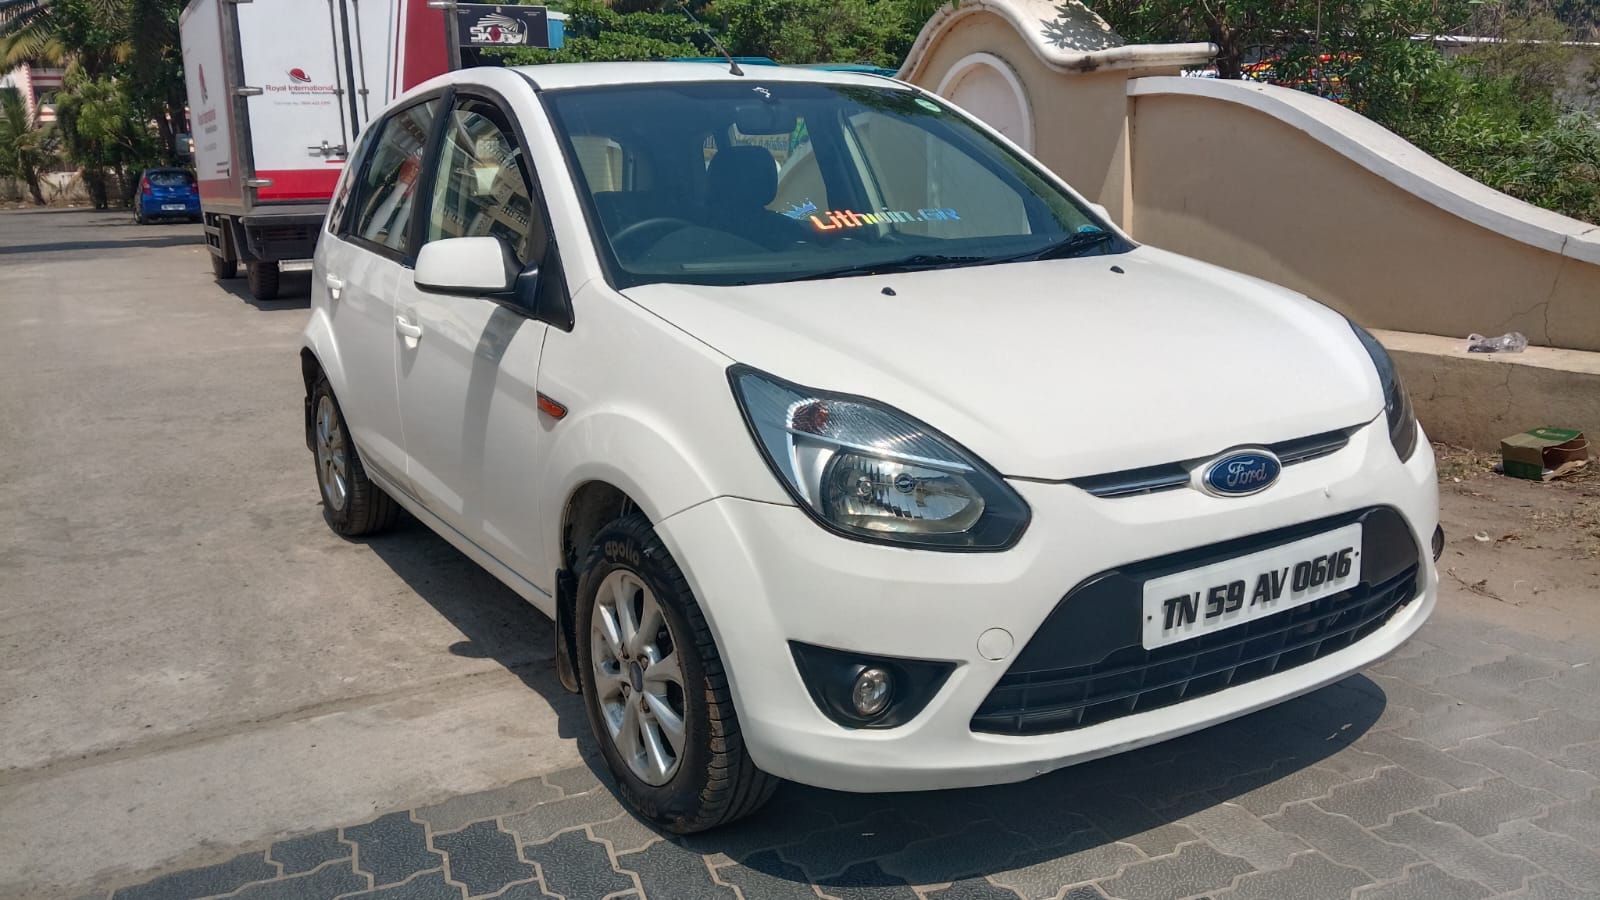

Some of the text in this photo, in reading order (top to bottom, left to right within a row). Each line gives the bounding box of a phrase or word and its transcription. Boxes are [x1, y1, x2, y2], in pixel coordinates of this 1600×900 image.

[265, 84, 286, 93] Royal
[288, 84, 334, 92] International
[1226, 459, 1268, 487] Ford
[604, 538, 640, 566] apollo
[1163, 547, 1354, 630] TN 59 AV 0616
